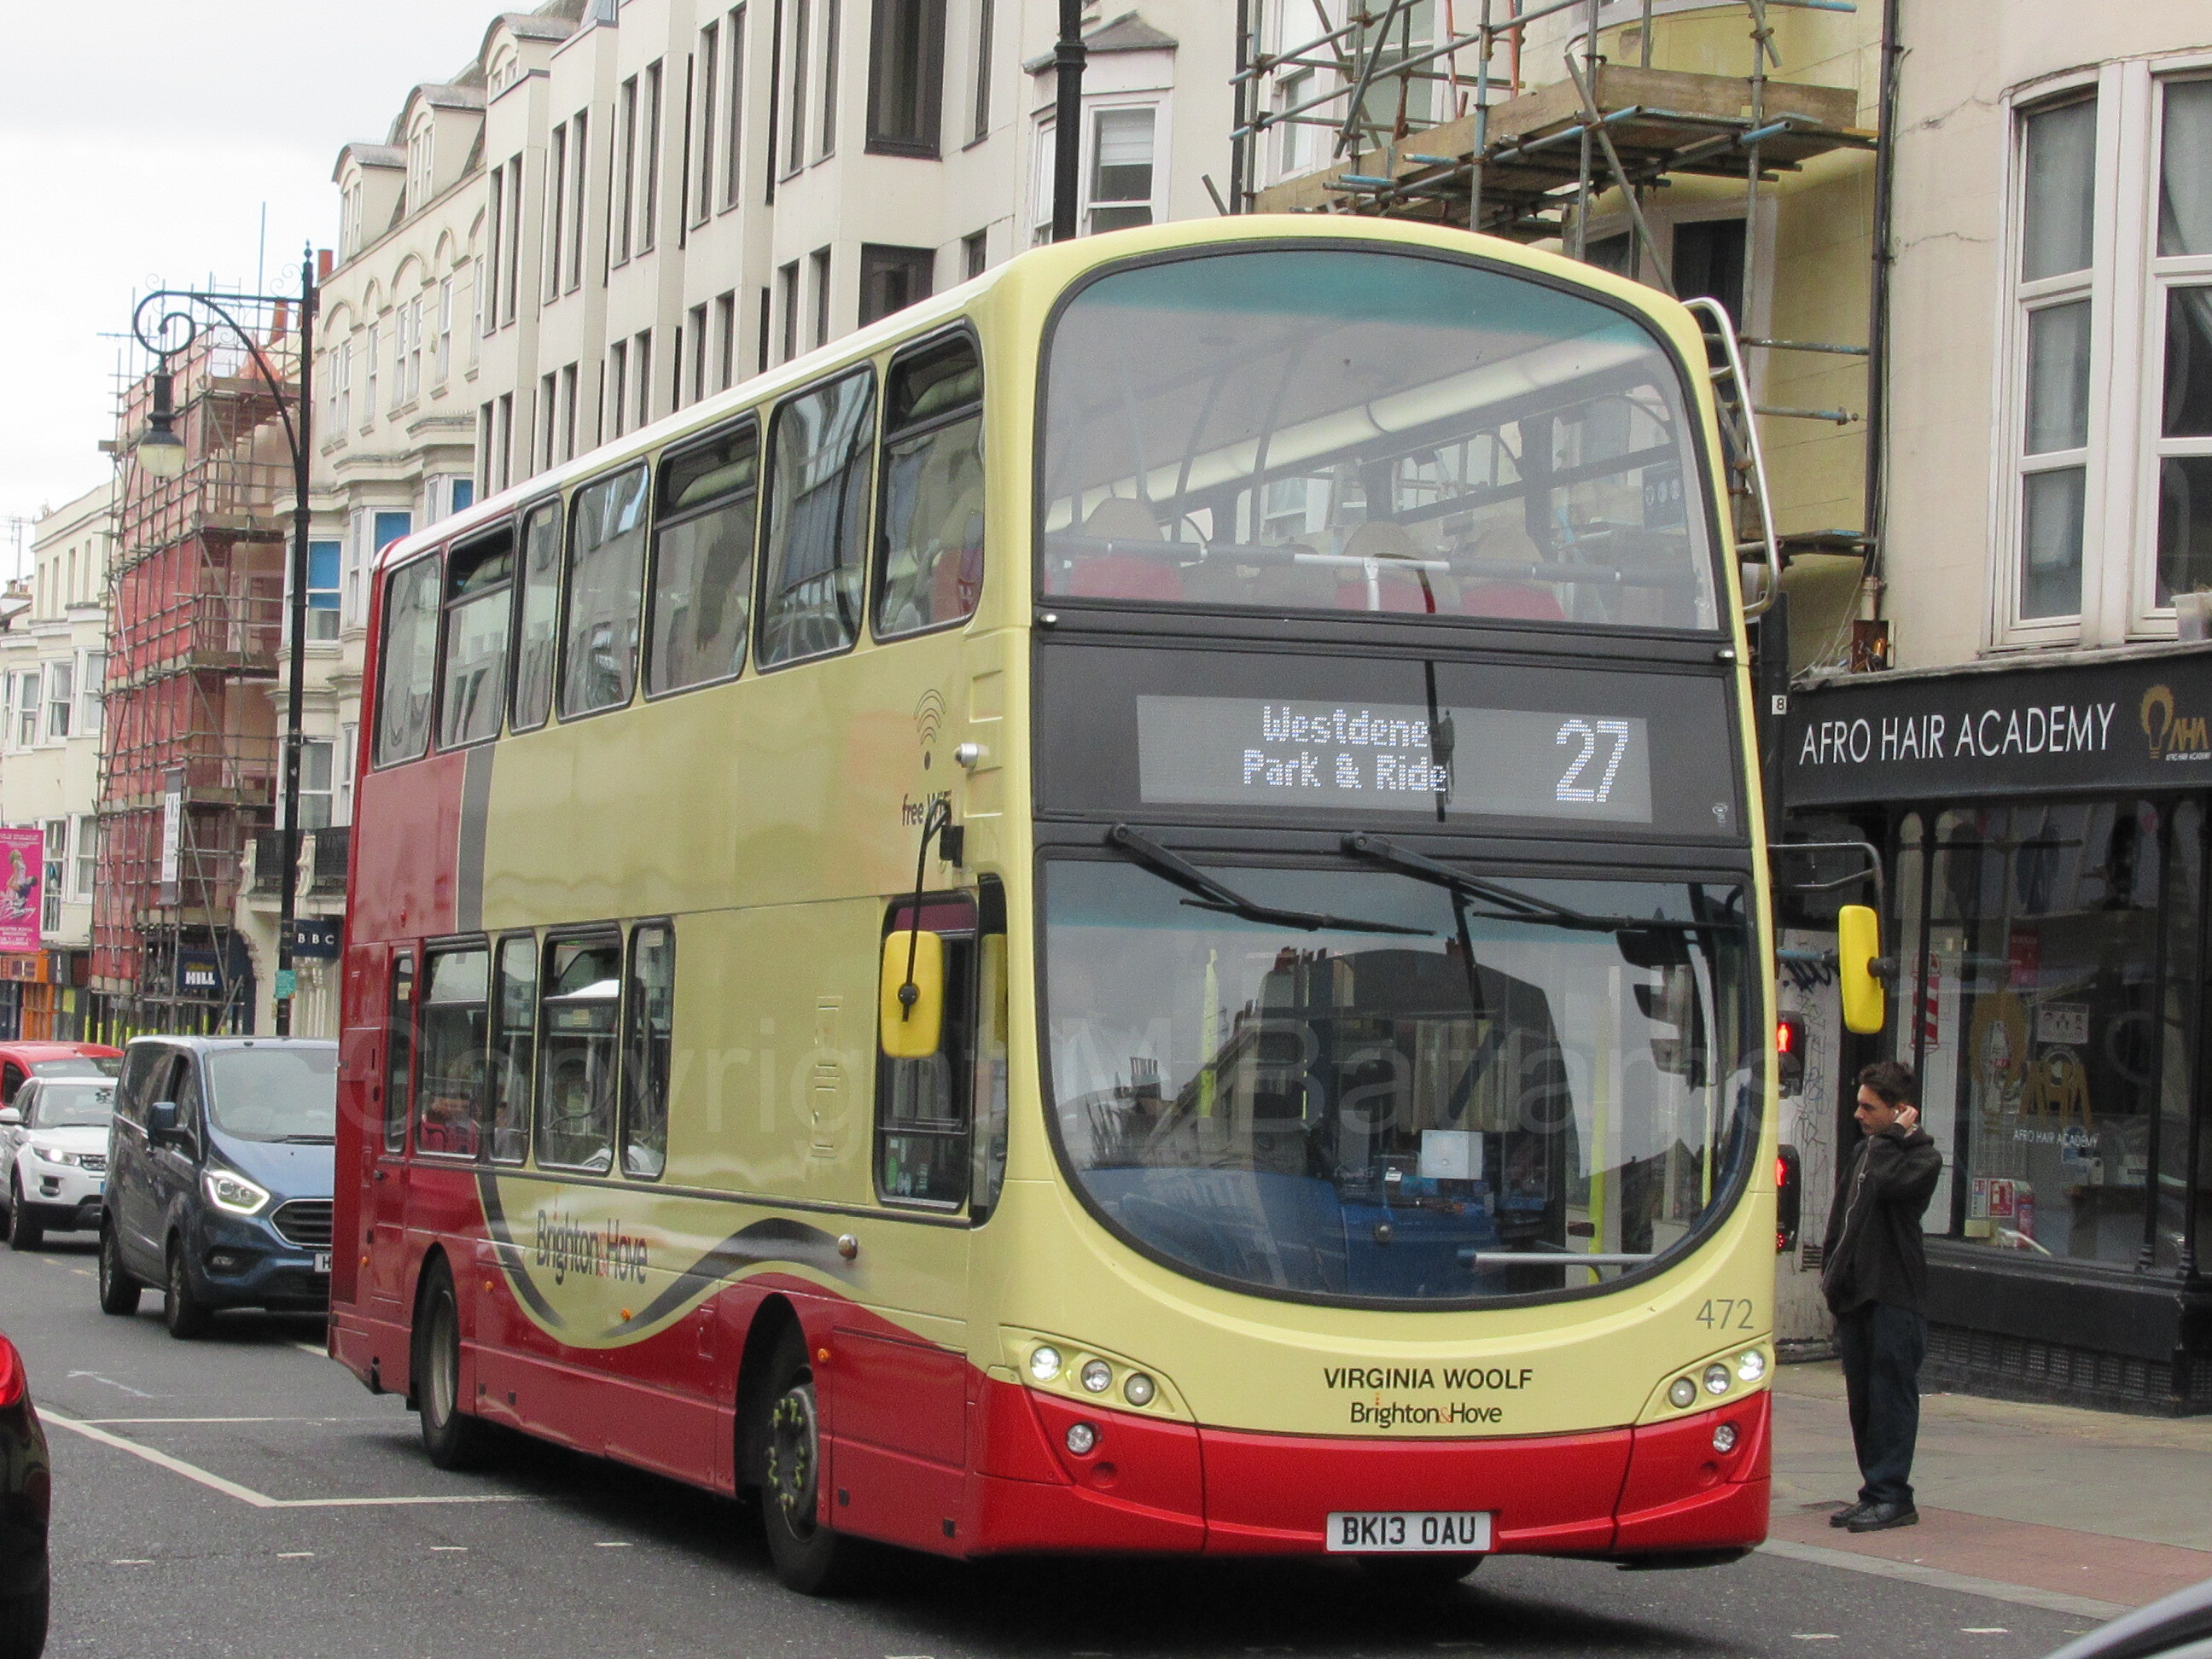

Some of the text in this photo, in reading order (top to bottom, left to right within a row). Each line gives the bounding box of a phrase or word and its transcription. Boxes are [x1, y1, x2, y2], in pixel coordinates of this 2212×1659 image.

[1262, 705, 1430, 748] Westdene
[1799, 701, 2116, 765] AFRO HAIR ACADEMY
[1243, 748, 1448, 794] Park & Ride
[1555, 718, 1630, 803] 27
[902, 793, 924, 827] free
[297, 932, 335, 946] BBC
[185, 970, 216, 986] HILL
[2012, 1128, 2035, 1144] AFRO
[1695, 1298, 1755, 1330] 472
[1323, 1367, 1534, 1390] VIRGINIA WOOLF
[1342, 1516, 1476, 1545] BK13 OAU
